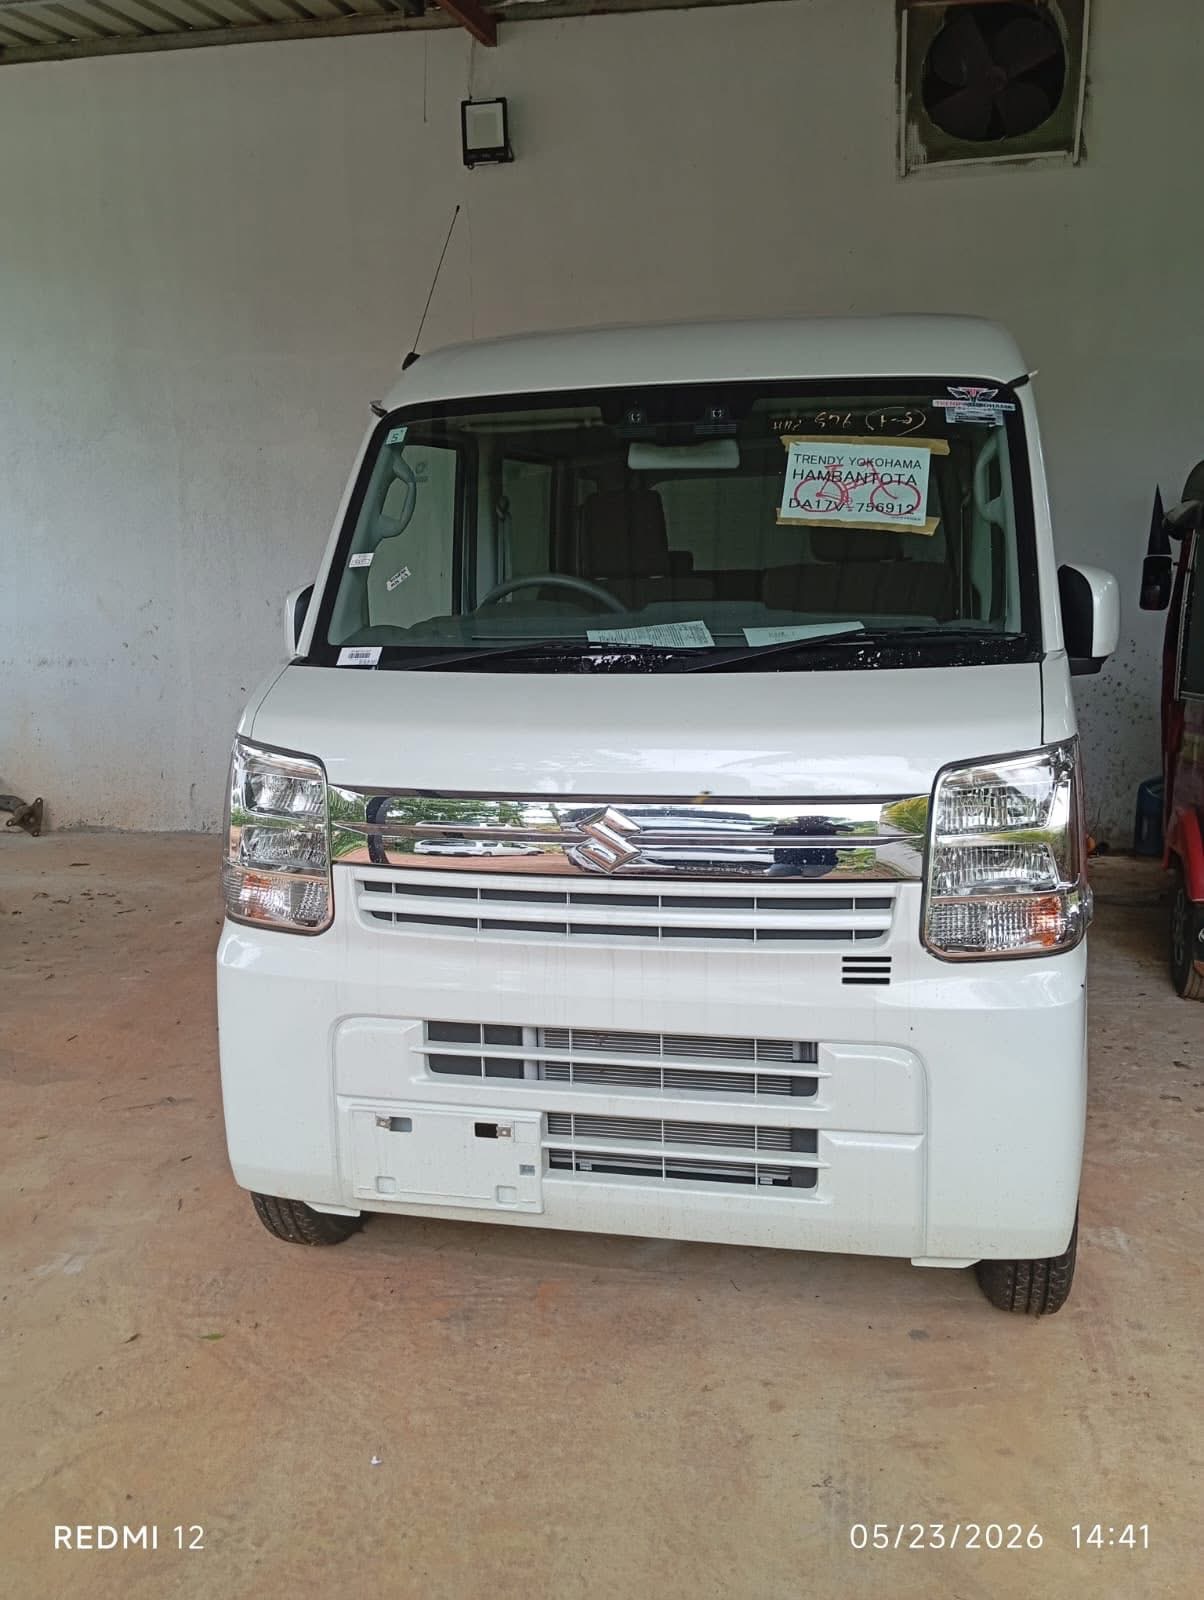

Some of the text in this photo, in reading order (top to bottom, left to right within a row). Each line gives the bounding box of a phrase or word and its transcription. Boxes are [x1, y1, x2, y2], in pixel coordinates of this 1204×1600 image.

[793, 453, 922, 469] TRENDY YOKOHAMA
[792, 468, 917, 486] HAMBANTOTA
